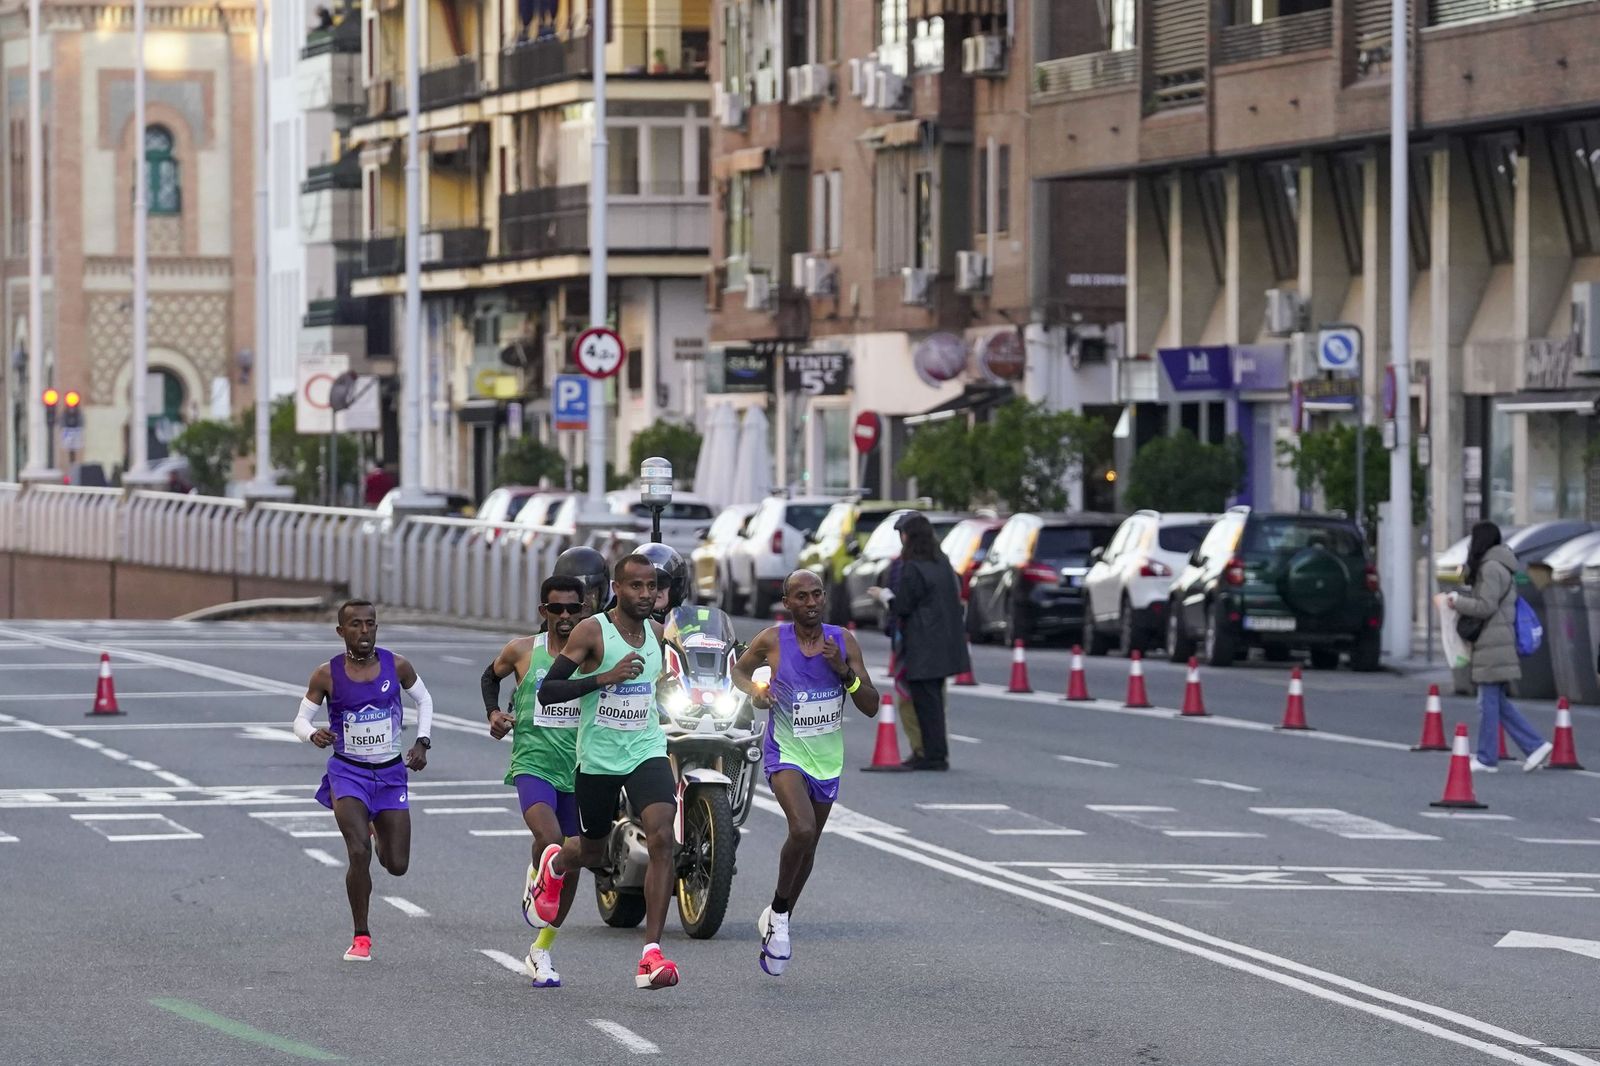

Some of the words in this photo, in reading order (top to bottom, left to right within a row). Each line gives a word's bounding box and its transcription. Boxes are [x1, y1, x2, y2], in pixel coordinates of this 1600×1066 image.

[558, 380, 582, 411] P
[619, 684, 647, 694] ZURICH
[811, 690, 839, 700] ZURICH
[359, 711, 386, 721] ZURICH
[541, 706, 582, 717] MESFUN
[351, 733, 386, 745] TSEDAT
[1048, 867, 1594, 891] EXCE
